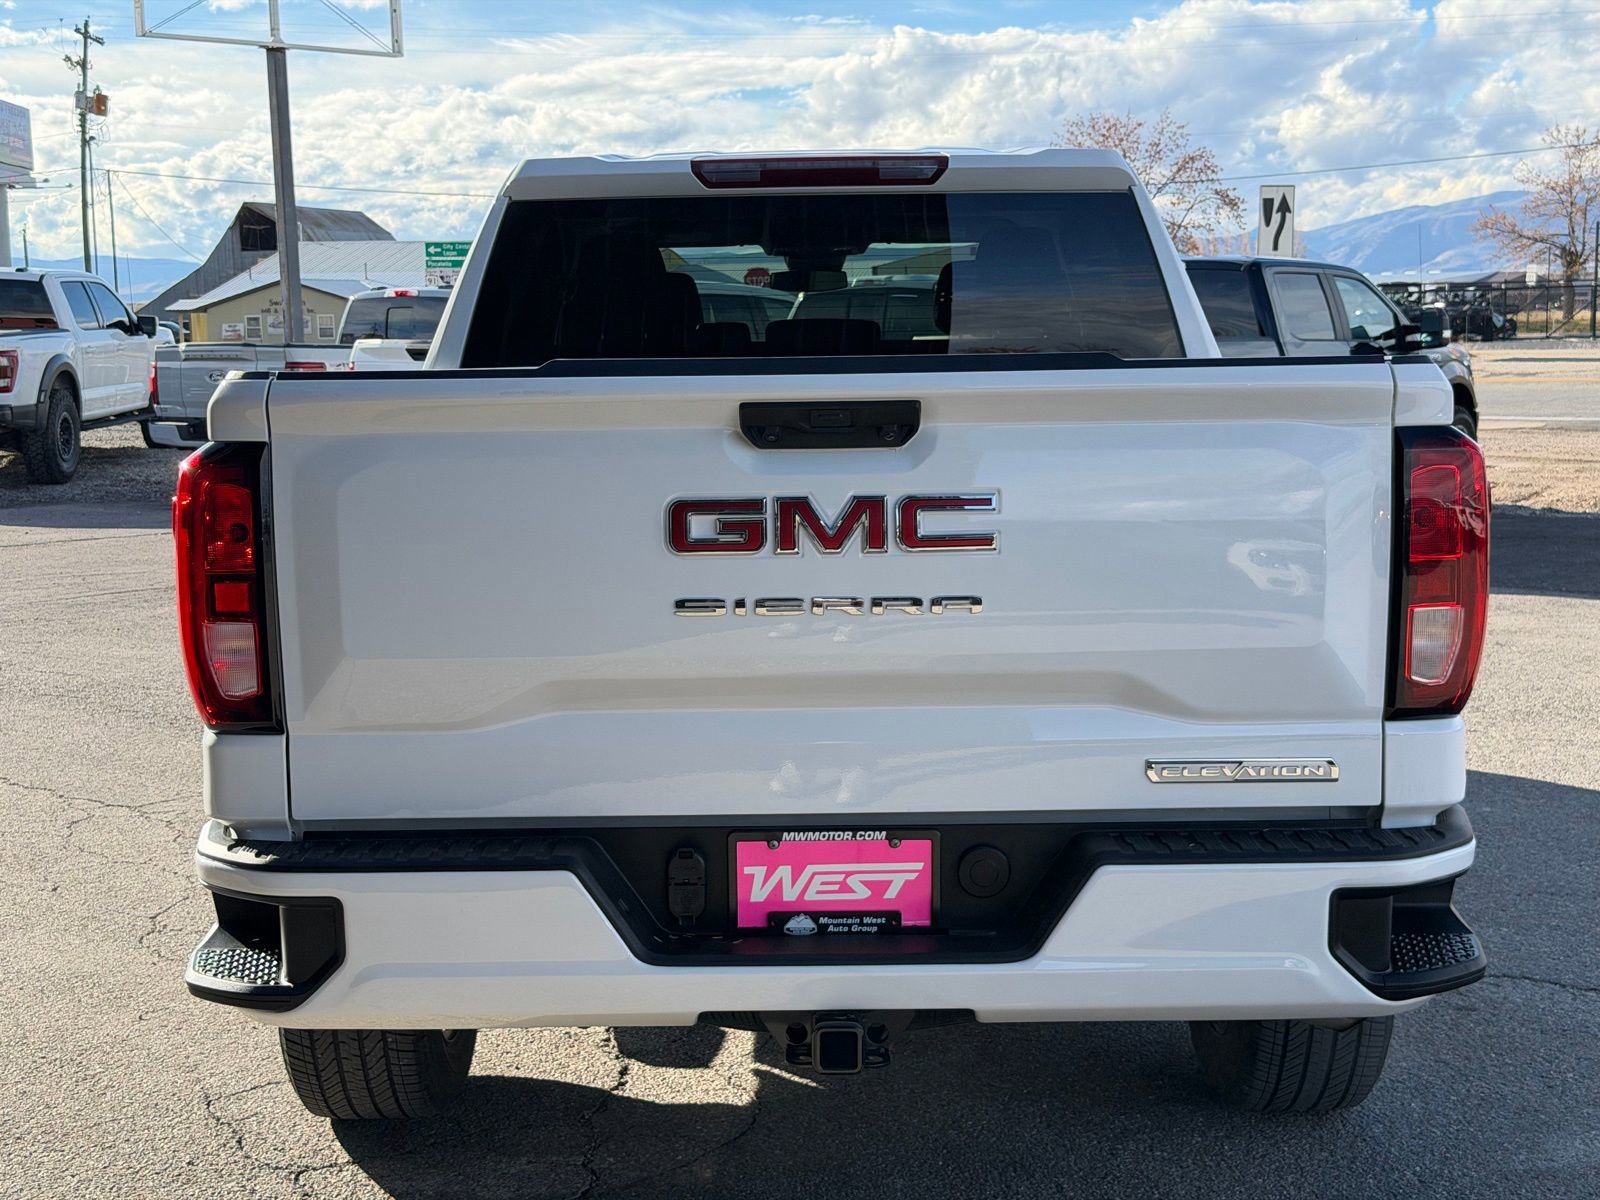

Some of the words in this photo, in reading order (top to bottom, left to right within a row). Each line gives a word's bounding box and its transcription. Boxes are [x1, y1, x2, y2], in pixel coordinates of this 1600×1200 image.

[746, 275, 770, 287] STOP
[667, 493, 999, 556] GMC
[673, 595, 984, 617] SIERRA
[1161, 764, 1325, 777] ELEVATION
[782, 830, 886, 841] MWMOTOR.COM
[818, 916, 860, 925] Mountain
[862, 916, 886, 924] West
[827, 924, 849, 932] Auto
[851, 924, 878, 933] Group
